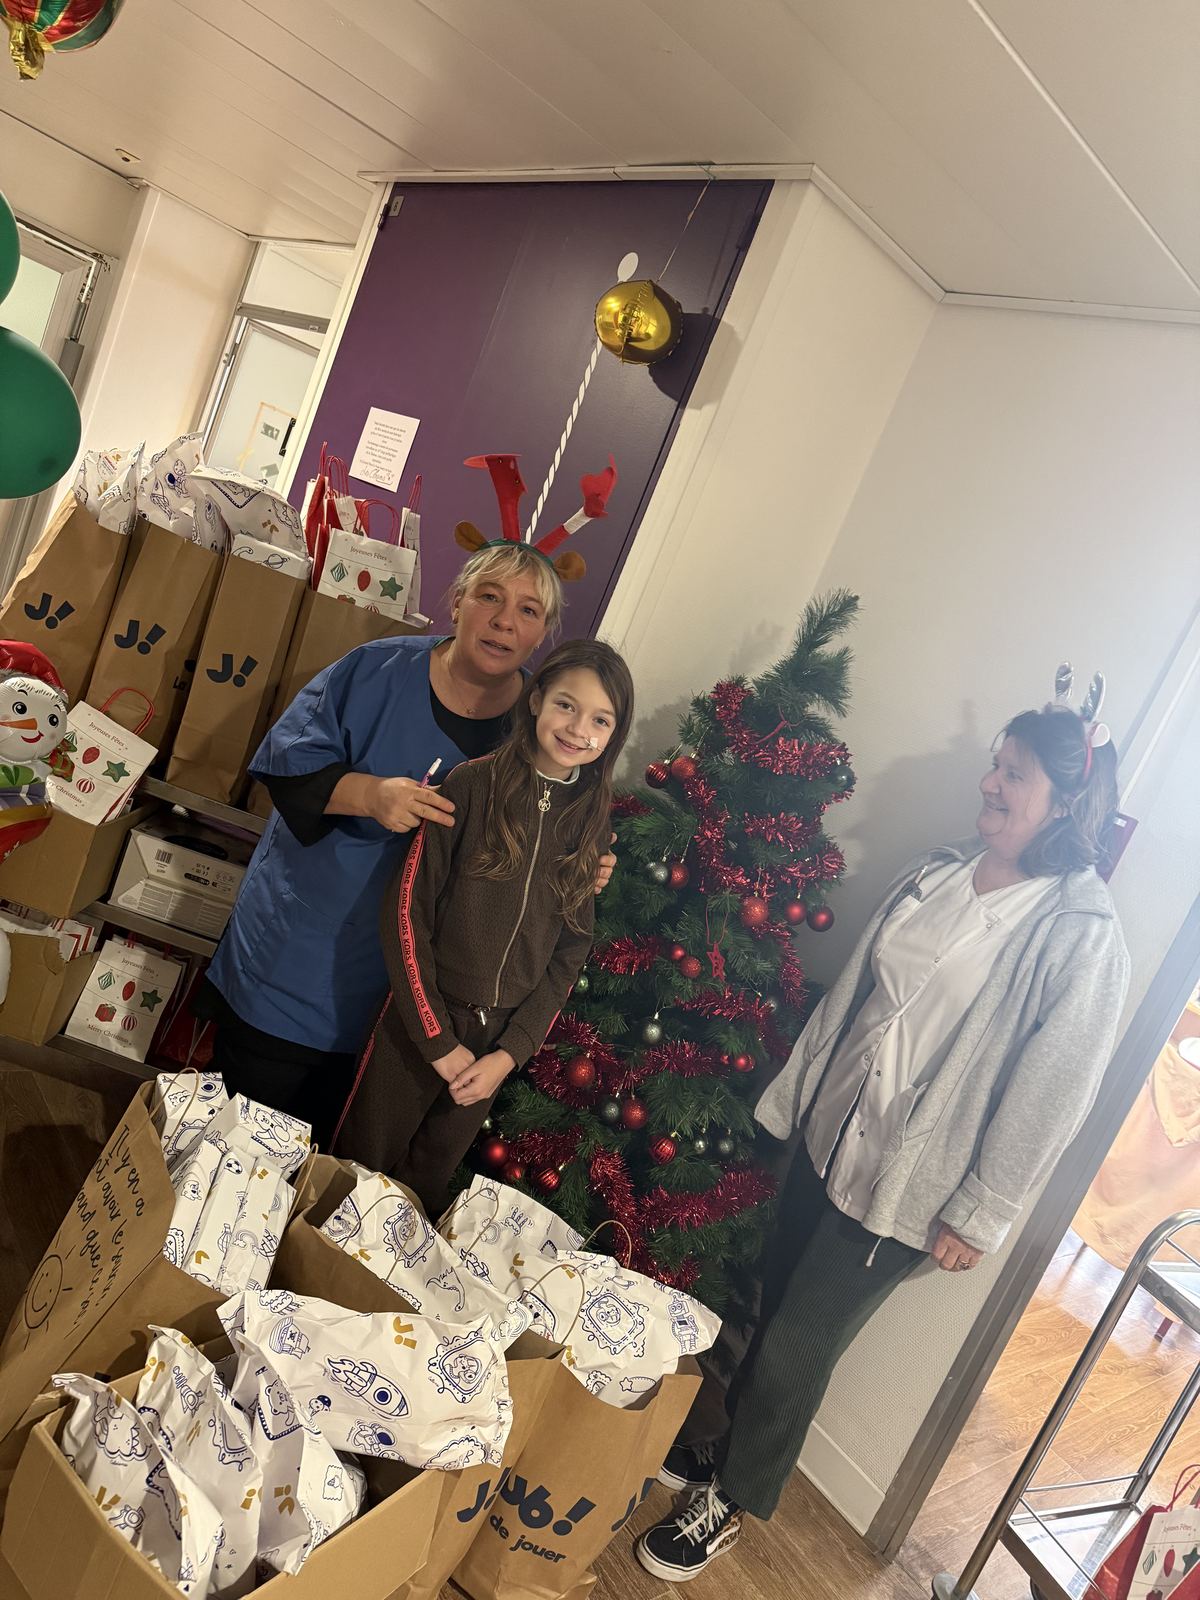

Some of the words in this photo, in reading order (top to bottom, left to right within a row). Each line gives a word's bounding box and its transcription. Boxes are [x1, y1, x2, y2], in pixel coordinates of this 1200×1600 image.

[24, 592, 75, 630] J!
[114, 619, 167, 655] J!
[206, 653, 258, 688] J!
[89, 721, 111, 740] Joyeuses
[400, 913, 409, 936] KORS
[403, 938, 412, 961] KORS
[407, 962, 418, 985] KORS
[415, 986, 427, 1009] KORS
[423, 1010, 437, 1033] KORS
[108, 1124, 130, 1159] Il
[127, 1167, 141, 1195] en
[135, 1197, 145, 1217] a
[102, 1182, 121, 1222] avoir
[112, 1218, 126, 1246] le
[490, 1514, 510, 1540] de
[509, 1534, 567, 1564] jouer
